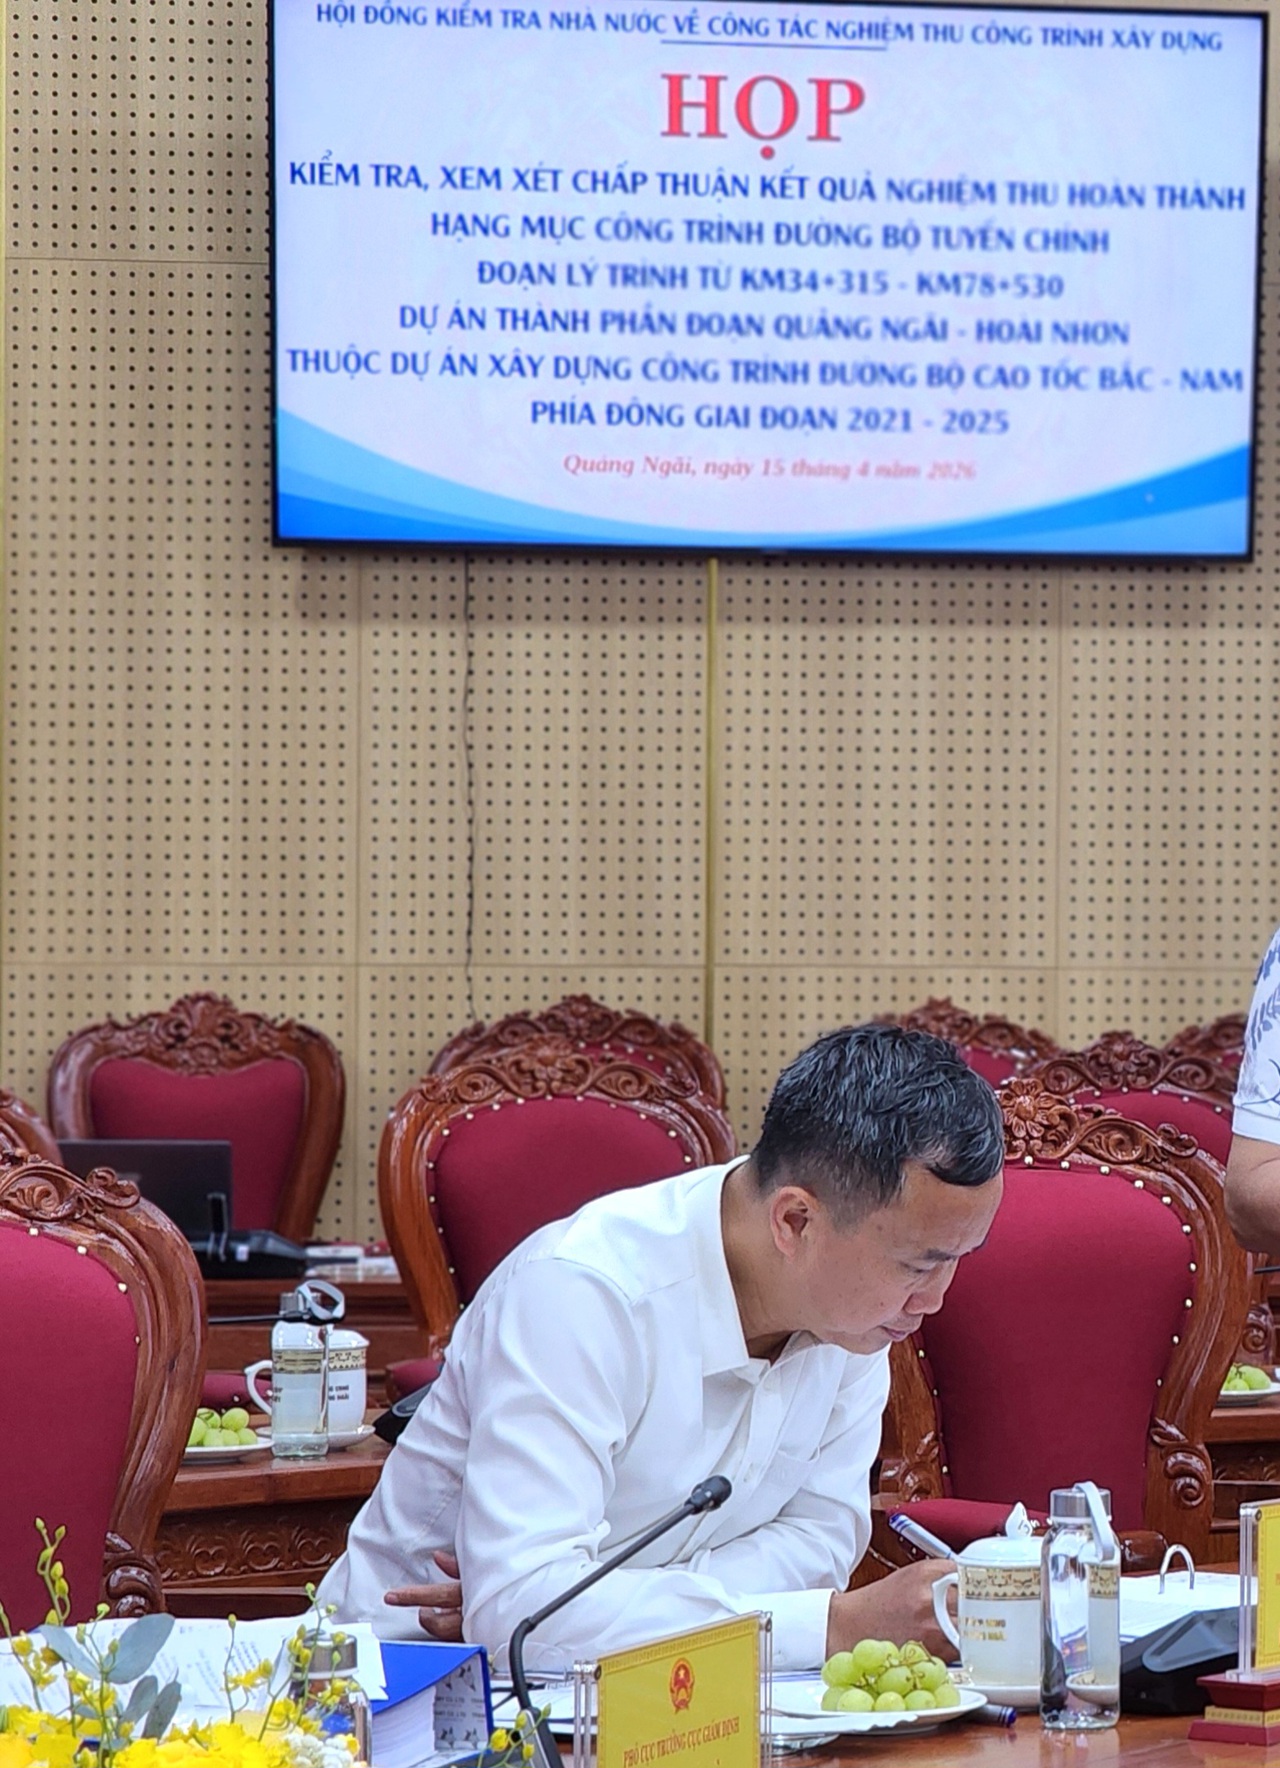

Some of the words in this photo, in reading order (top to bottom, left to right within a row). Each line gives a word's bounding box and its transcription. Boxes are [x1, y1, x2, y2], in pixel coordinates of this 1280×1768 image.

[500, 9, 542, 30] TRA
[550, 11, 597, 31] NHÀ
[604, 10, 666, 34] NƯỚC
[673, 7, 700, 35] VỀ
[707, 11, 770, 37] CÔNG
[777, 14, 817, 39] TÁC
[826, 17, 914, 44] NGHIỆM
[922, 23, 963, 43] THU
[970, 20, 1032, 45] CÔNG
[1041, 25, 1103, 47] TRÌNH
[1112, 26, 1154, 48] XÂY
[1161, 31, 1222, 54] DỰNG
[661, 73, 865, 160] HỌP
[290, 149, 361, 187] KIỂM
[369, 164, 429, 192] TRA,
[439, 165, 502, 191] XEM
[512, 161, 563, 193] XÉT
[571, 161, 648, 195] CHẤP
[656, 166, 749, 203] THUẬN
[760, 163, 810, 200] KẾT
[818, 170, 877, 203] QUẢ
[886, 175, 997, 206] NGHIỆM
[1006, 181, 1058, 206] THU
[1067, 182, 1146, 208] HOÀN
[1154, 184, 1245, 210] THÀNH
[431, 212, 511, 242] HẠNG
[521, 214, 585, 245] MỤC
[594, 211, 674, 243] CÔNG
[683, 214, 764, 245] TRÌNH
[773, 217, 873, 248] ĐƯỜNG
[881, 220, 921, 252] BỘ
[930, 220, 1015, 251] TUYẾN
[1023, 224, 1110, 254] CHÍNH
[477, 260, 557, 291] ĐOẠN
[566, 258, 599, 287] LÝ
[607, 260, 689, 289] TRÌNH
[698, 260, 732, 291] TỪ
[740, 267, 889, 295] KM34+315
[916, 271, 1064, 299] KM78+530
[399, 305, 439, 335] DỰ
[447, 300, 486, 331] ÁN
[495, 303, 590, 333] THÀNH
[600, 302, 677, 335] PHẦN
[685, 311, 765, 342] ĐOẠN
[773, 308, 872, 341] QUẢNG
[881, 313, 949, 342] NGÃI
[975, 315, 1043, 344] HOÀI
[287, 344, 381, 379] THUỘC
[391, 351, 431, 381] DỰ
[439, 346, 478, 377] ÁN
[488, 348, 545, 378] XÂY
[553, 355, 632, 385] DỰNG
[641, 353, 720, 383] CÔNG
[729, 358, 810, 385] TRÌNH
[818, 360, 918, 388] ĐƯỜNG
[926, 360, 966, 390] BỘ
[972, 364, 1031, 389] CAO
[1039, 357, 1089, 391] TỐC
[1098, 359, 1153, 391] BẮC
[1180, 368, 1243, 392] NAM
[531, 396, 597, 426] PHÍA
[605, 396, 685, 428] ĐÔNG
[694, 404, 751, 429] GIAI
[759, 405, 838, 435] ĐOẠN
[847, 407, 912, 433] 2021
[942, 409, 1009, 434] 2025
